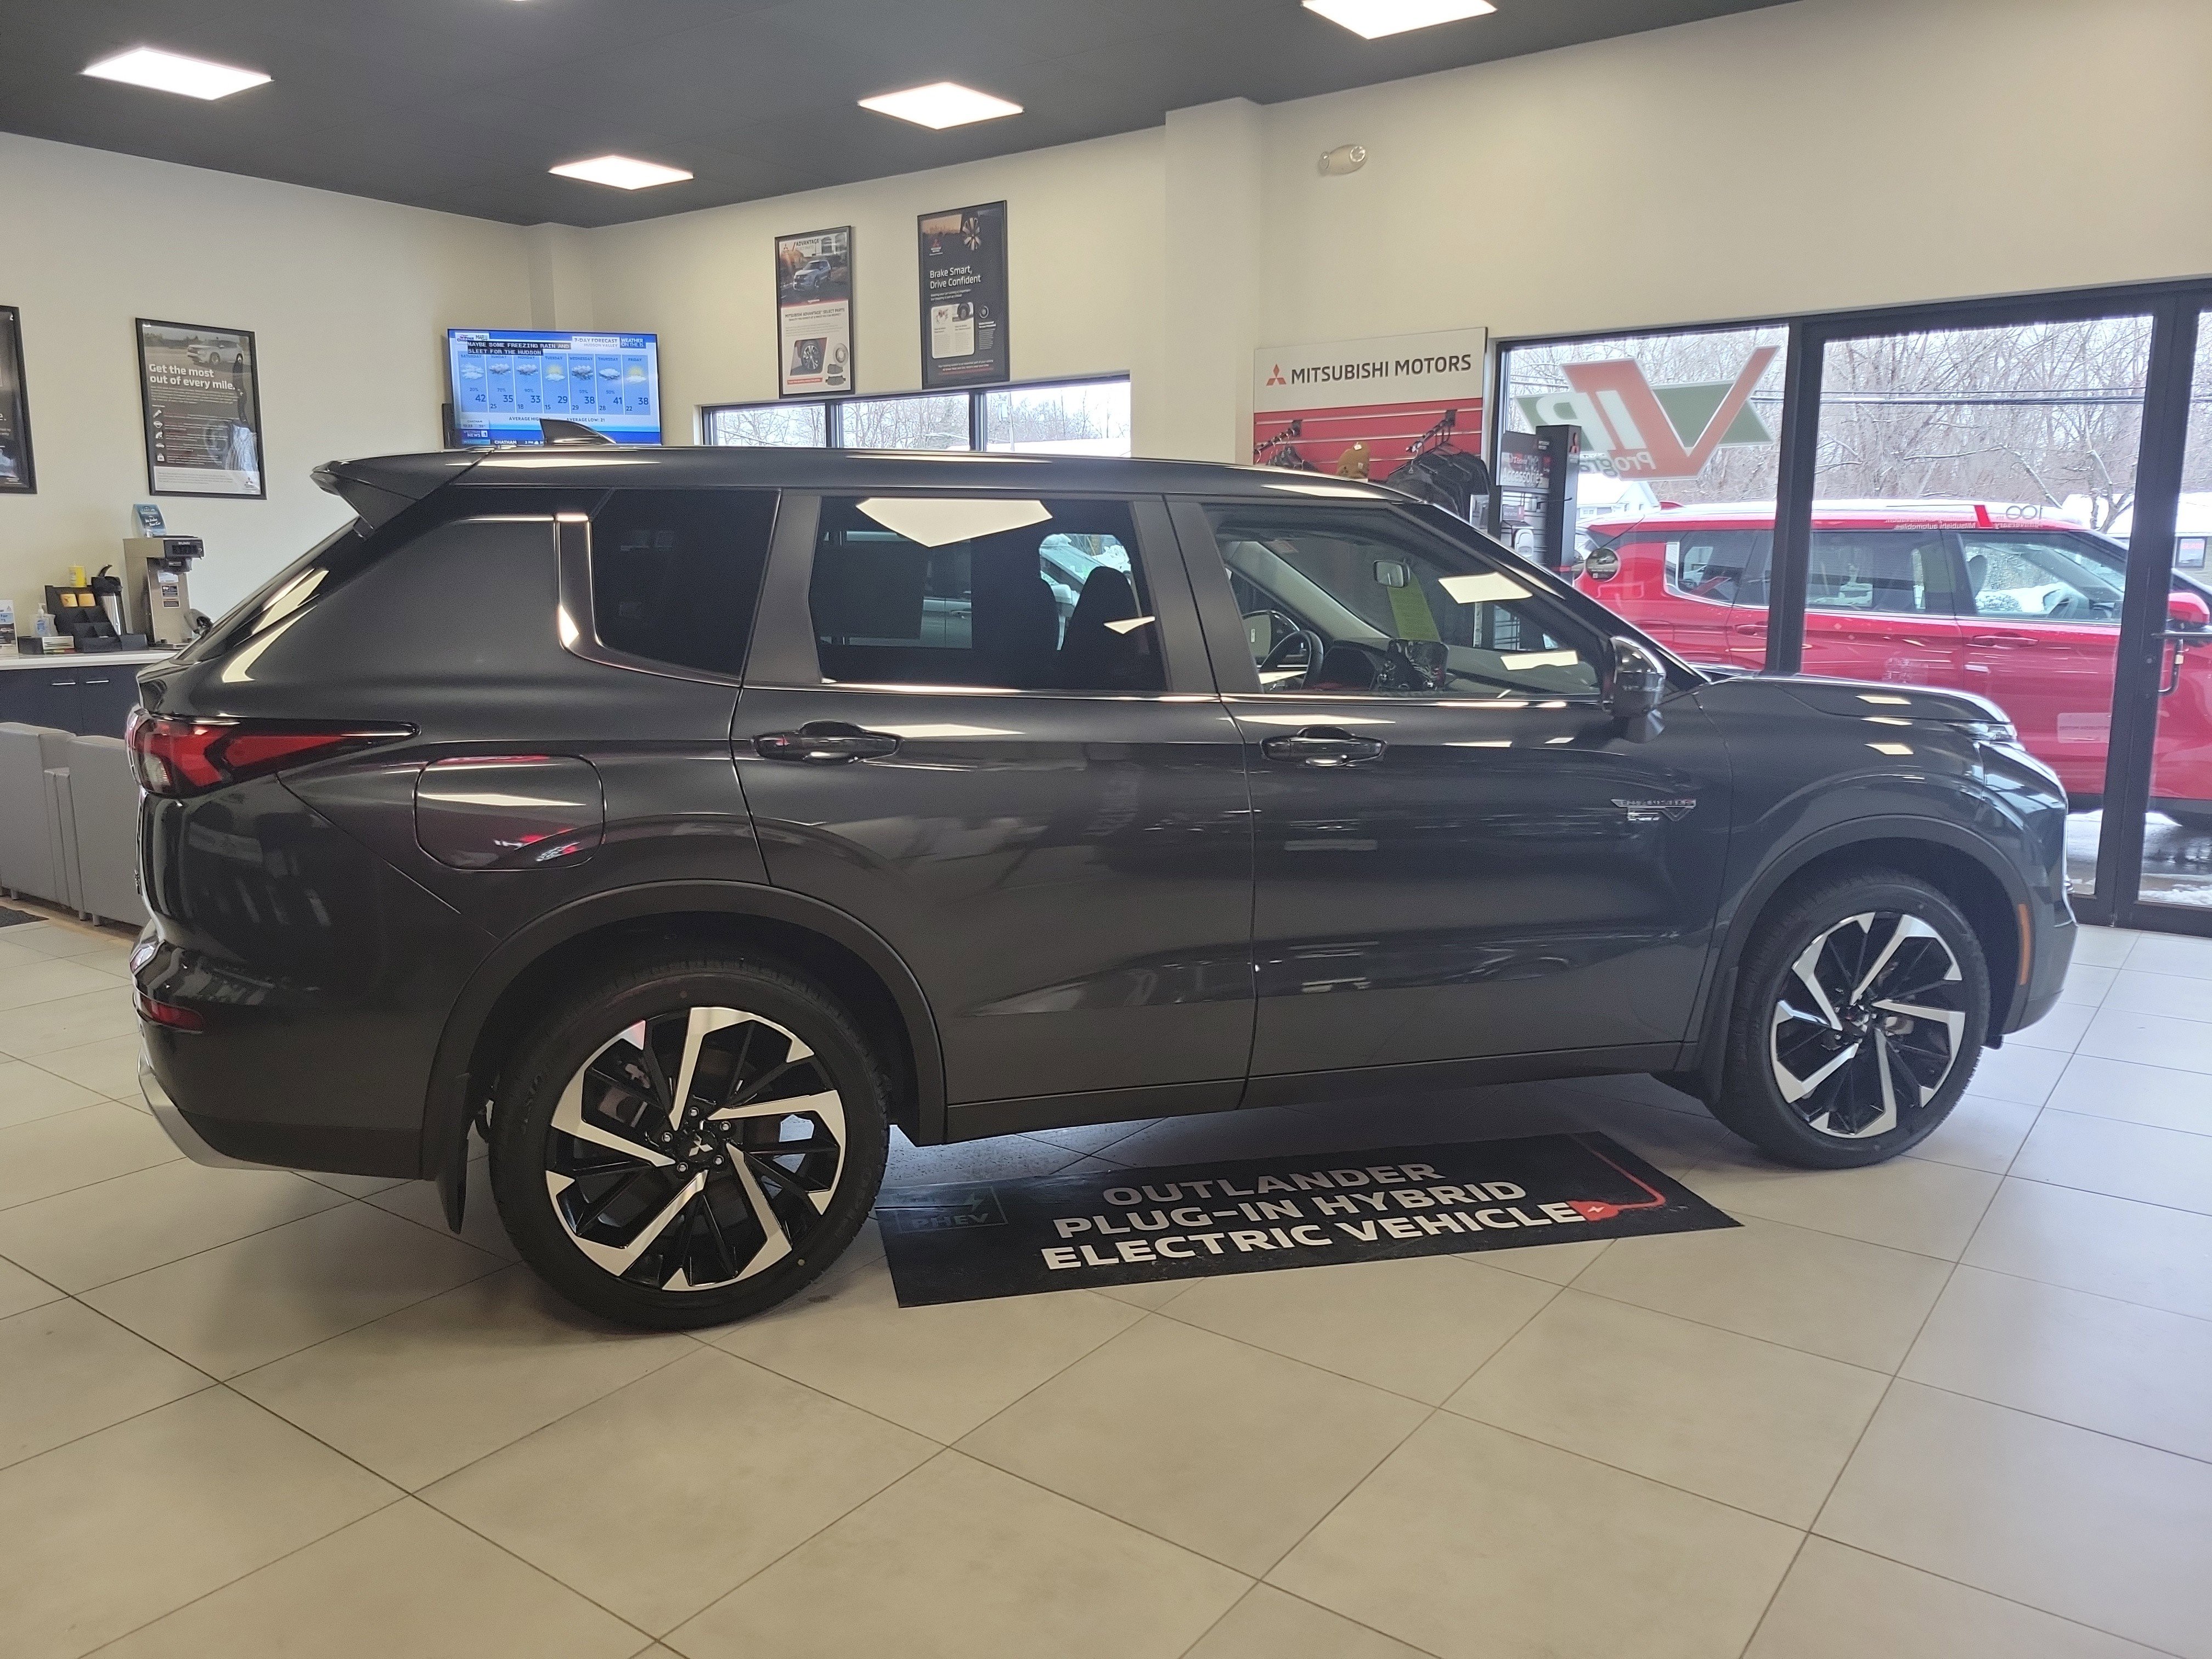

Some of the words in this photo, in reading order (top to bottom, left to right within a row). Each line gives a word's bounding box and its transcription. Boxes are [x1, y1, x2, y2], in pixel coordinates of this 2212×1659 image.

[930, 269, 949, 279] Brake
[950, 265, 972, 276] Smart,
[930, 280, 947, 289] Drive
[948, 274, 981, 286] Confident
[149, 363, 167, 373] Get
[170, 365, 187, 375] the
[188, 368, 215, 378] most
[1291, 360, 1389, 385] MITSUBISHI
[1394, 354, 1472, 377] MOTORS
[150, 376, 168, 384] out
[170, 376, 182, 385] of
[183, 379, 211, 390] every
[212, 380, 236, 390] mile.
[475, 394, 486, 402] 42
[503, 394, 514, 403] 35
[531, 395, 541, 403] 33
[557, 396, 568, 404] 29
[584, 396, 595, 404] 38
[613, 397, 623, 405] 41
[638, 397, 649, 405] 38
[1502, 468, 1543, 486] Accessories
[1102, 1163, 1447, 1206] OUTLANDER
[1053, 1199, 1305, 1239] PLUG-IN
[1311, 1181, 1527, 1215] HYBRID
[912, 1212, 989, 1229] PHEV
[1040, 1224, 1334, 1270] ELECTRIC
[1334, 1201, 1587, 1243] VEHICLE
